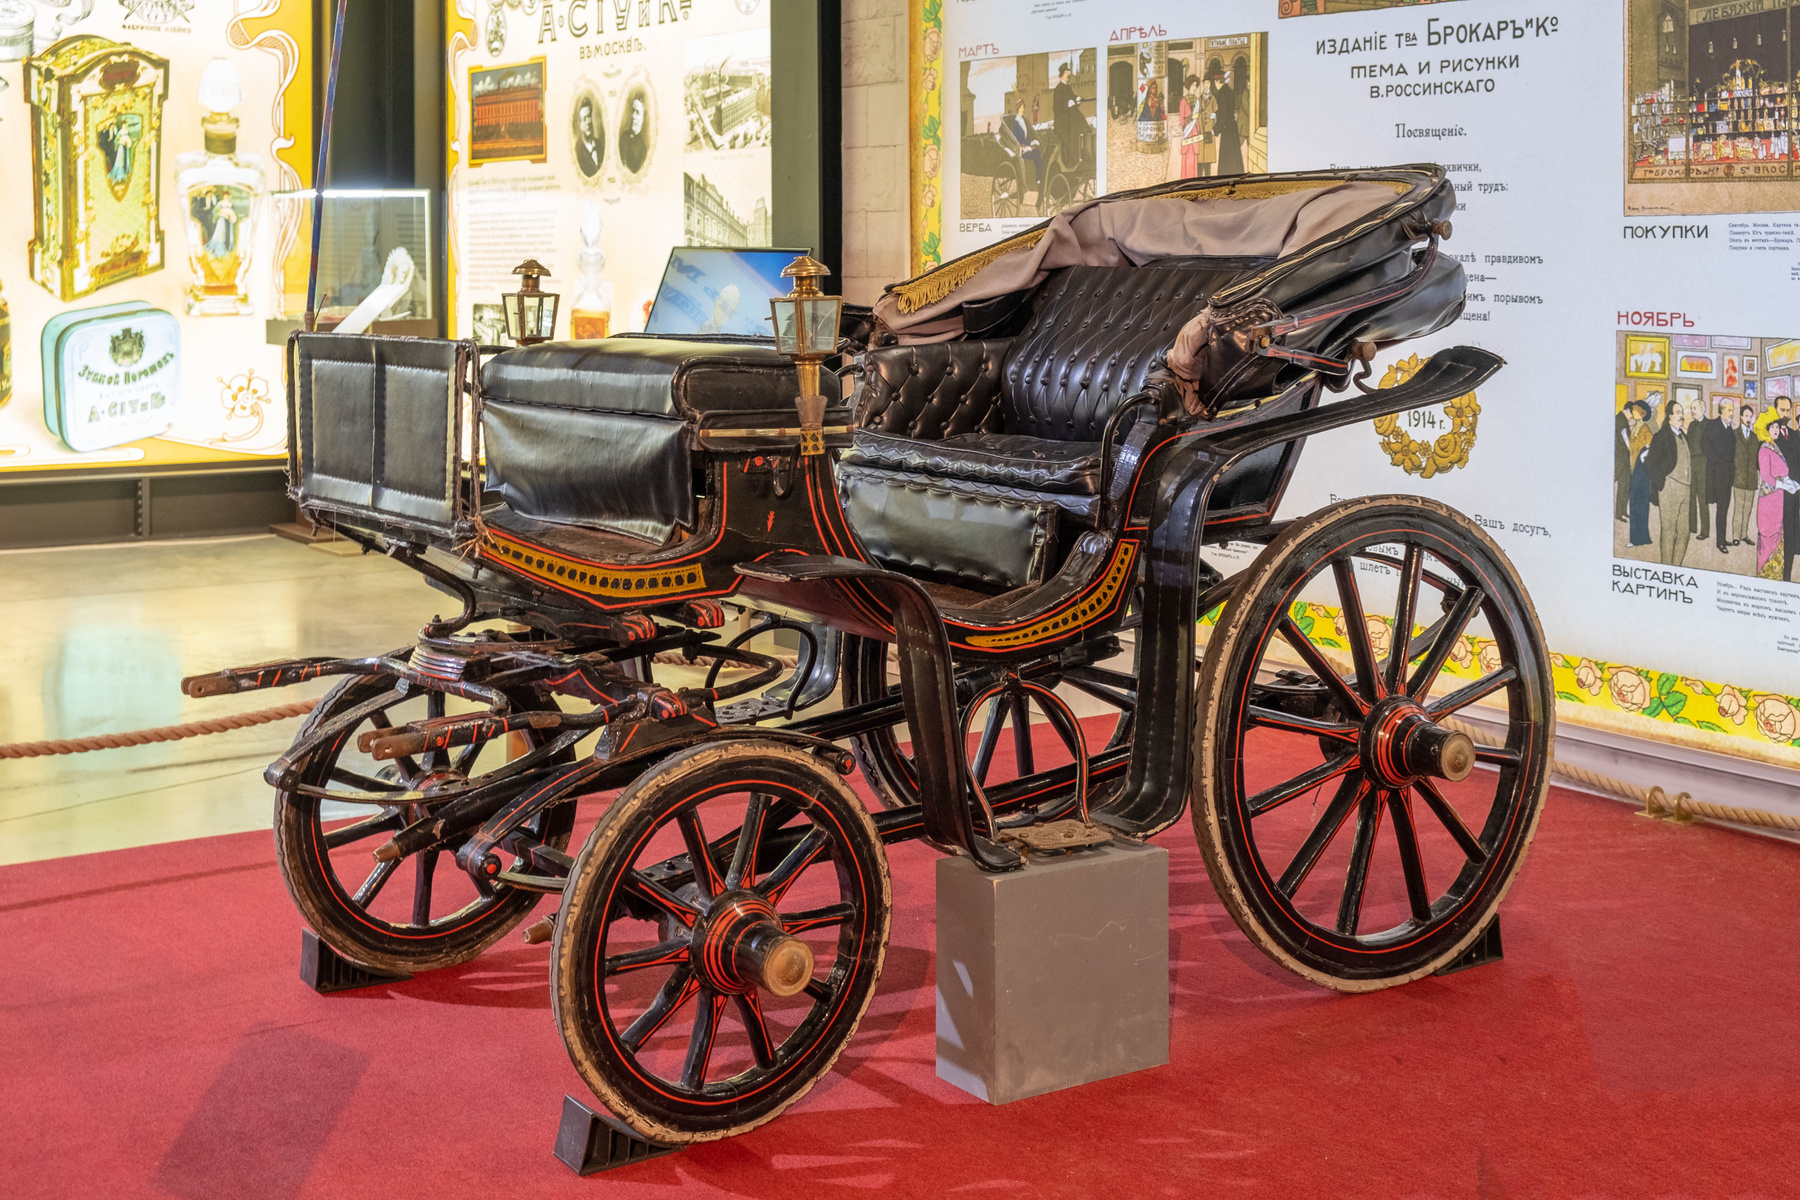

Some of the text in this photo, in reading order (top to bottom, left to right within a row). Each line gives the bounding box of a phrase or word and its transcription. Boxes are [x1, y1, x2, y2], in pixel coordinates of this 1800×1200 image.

[958, 43, 1000, 58] МАРТЪ
[1316, 31, 1387, 55] ИЗДАНІЕ
[1440, 54, 1520, 74] РИСУНКИ
[1395, 123, 1467, 140] Посвященіе.
[1478, 183, 1509, 194] трудъ:
[959, 223, 992, 232] ВЕРБА
[1623, 224, 1709, 239] ПОКУПКИ
[1484, 254, 1544, 266] правдивомъ
[1493, 293, 1544, 305] порывомъ
[1617, 310, 1695, 328] НОЯБРЬ
[1407, 410, 1436, 429] 1914
[1359, 561, 1391, 575] шлетъ
[1612, 564, 1699, 589] ВЫСТАВКА
[1612, 580, 1693, 604] КАРТИНЪ
